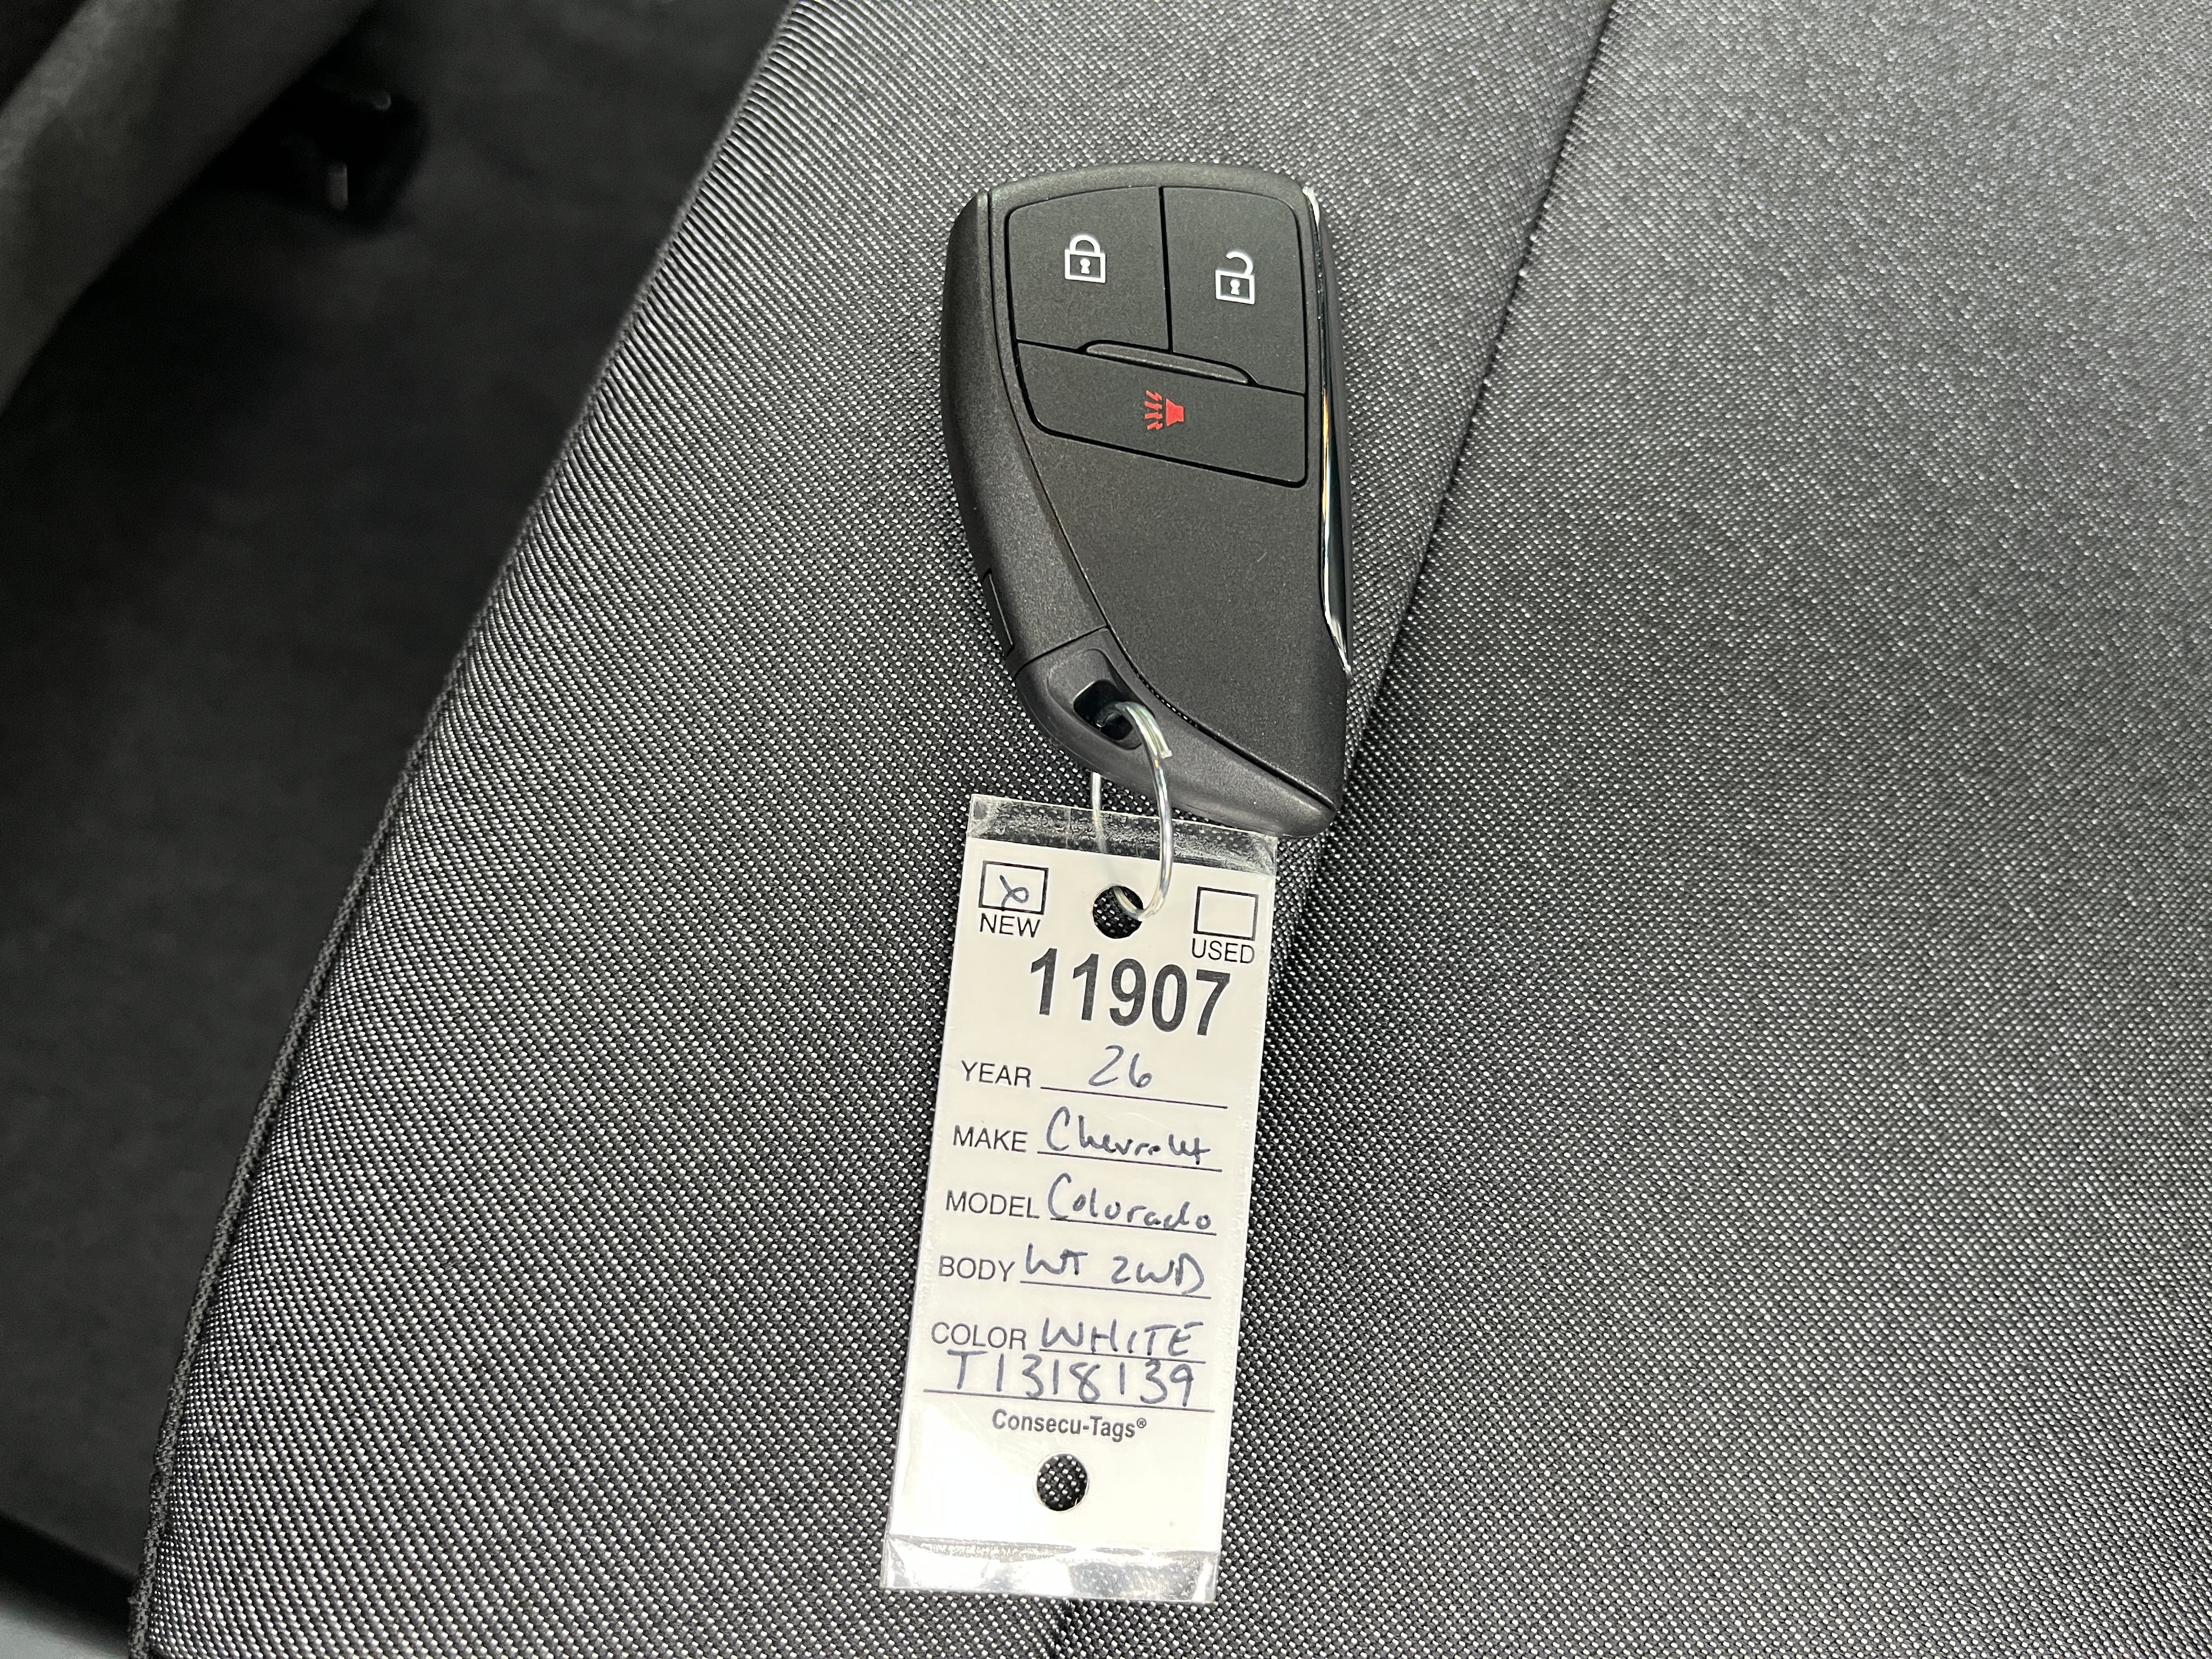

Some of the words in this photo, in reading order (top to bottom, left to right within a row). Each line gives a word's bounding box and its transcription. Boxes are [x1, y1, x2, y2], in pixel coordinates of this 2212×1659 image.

[979, 913, 1041, 938] NEW
[1192, 938, 1255, 964] USED
[1030, 948, 1231, 1036] 11907
[962, 1060, 1032, 1088] YEAR
[1088, 1045, 1153, 1088] 26
[952, 1125, 1029, 1153] MAKE
[945, 1189, 1040, 1219] MODEL
[1047, 1172, 1212, 1231] Colorado
[938, 1255, 1016, 1282] BODY
[1025, 1243, 1088, 1276] WT
[1110, 1252, 1206, 1296] 2WD
[931, 1321, 1027, 1350] COLOR
[1041, 1317, 1204, 1357] WHITE
[946, 1348, 1195, 1407] T1318139
